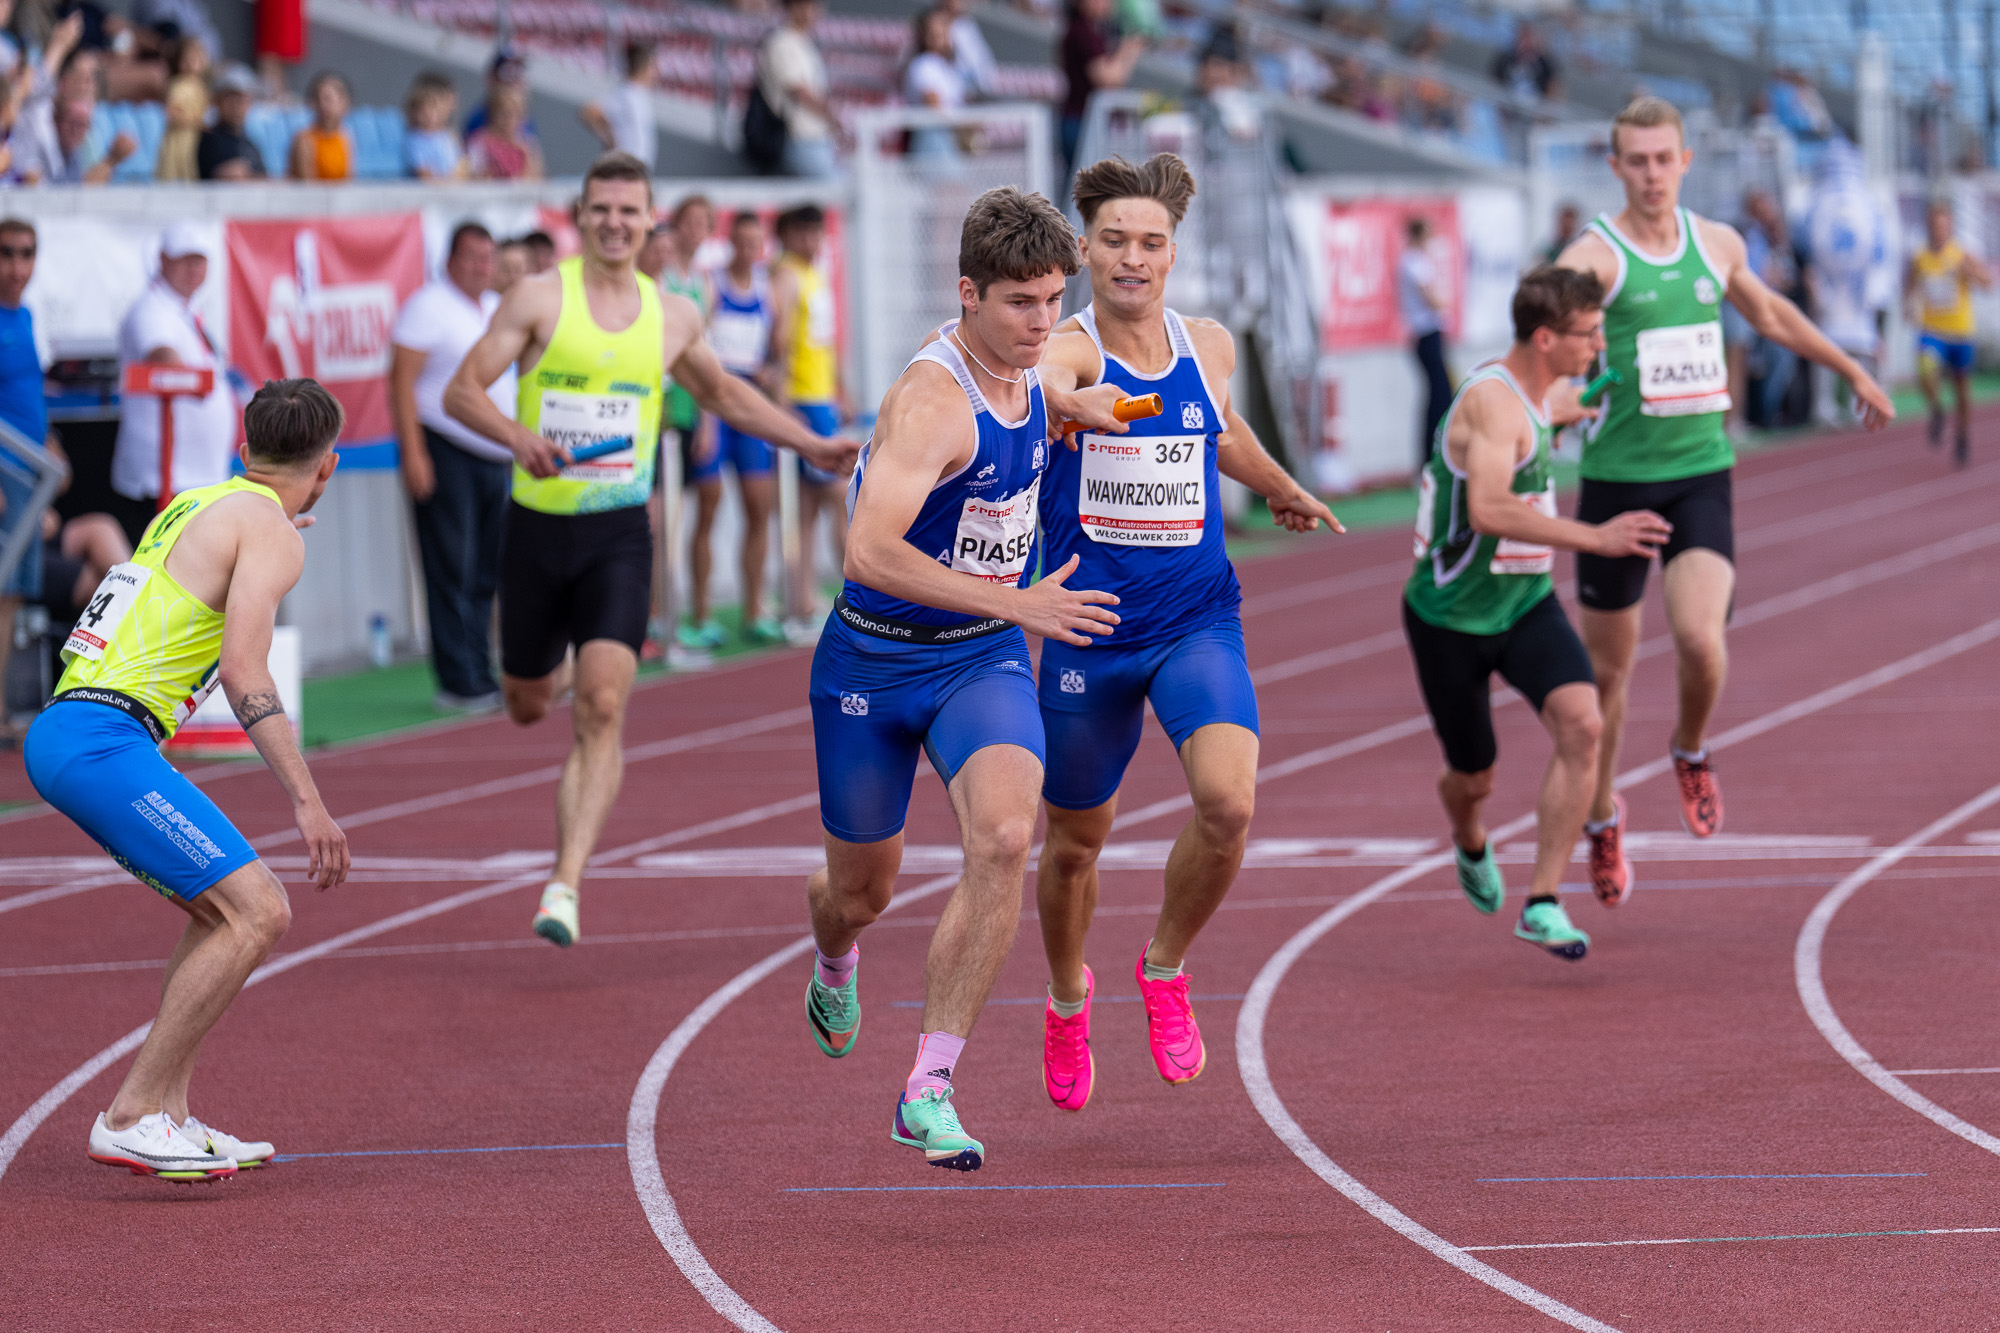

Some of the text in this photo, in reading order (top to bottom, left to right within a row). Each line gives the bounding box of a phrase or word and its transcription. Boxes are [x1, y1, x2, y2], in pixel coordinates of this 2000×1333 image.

[596, 400, 629, 419] 257
[1099, 445, 1141, 456] renex
[1155, 443, 1195, 463] 367
[1086, 478, 1200, 506] WAWRZKOWICZ
[1087, 517, 1197, 530] 40. PZLA Mistrzostwa Polski U23
[1094, 528, 1189, 542] WŁOCŁAWEK 2023
[841, 607, 912, 637] AdRunaLine
[934, 618, 1006, 640] AdRunaLine
[65, 690, 131, 711] AdRunaLine
[143, 791, 227, 859] KLUB SPORTOWY
